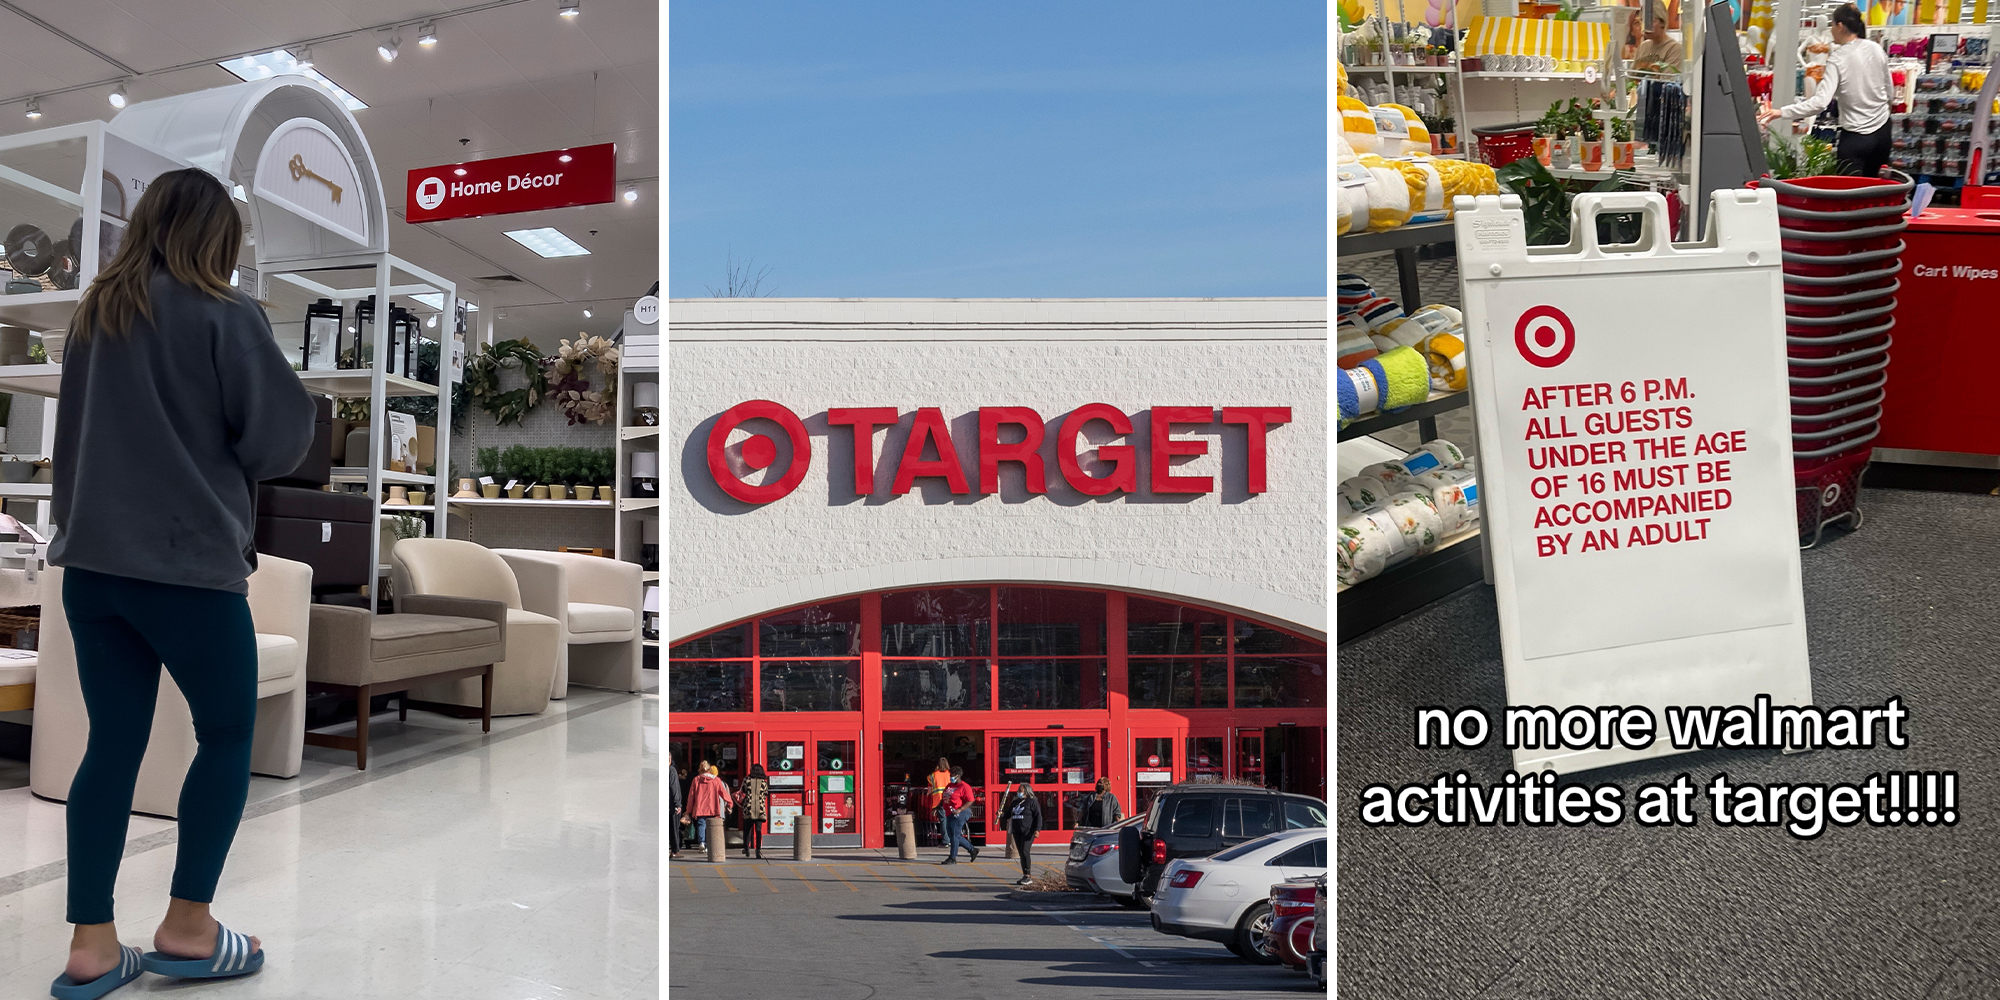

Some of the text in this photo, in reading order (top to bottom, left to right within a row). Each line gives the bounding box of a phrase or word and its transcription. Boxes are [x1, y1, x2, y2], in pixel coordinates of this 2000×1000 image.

[450, 172, 564, 198] Home Décor
[1913, 264, 1999, 281] Cart Wipes
[640, 305, 657, 313] H11
[1521, 377, 1695, 411] AFTER 6 P.M.
[1524, 406, 1693, 441] ALL GUESTS
[827, 402, 1293, 497] TARGET
[1527, 430, 1747, 471] UNDER THE AGE
[1530, 460, 1731, 500] OF 16 MUST BE
[1533, 489, 1732, 529] ACCOMPANIED
[1535, 517, 1711, 558] BY AN ADULT
